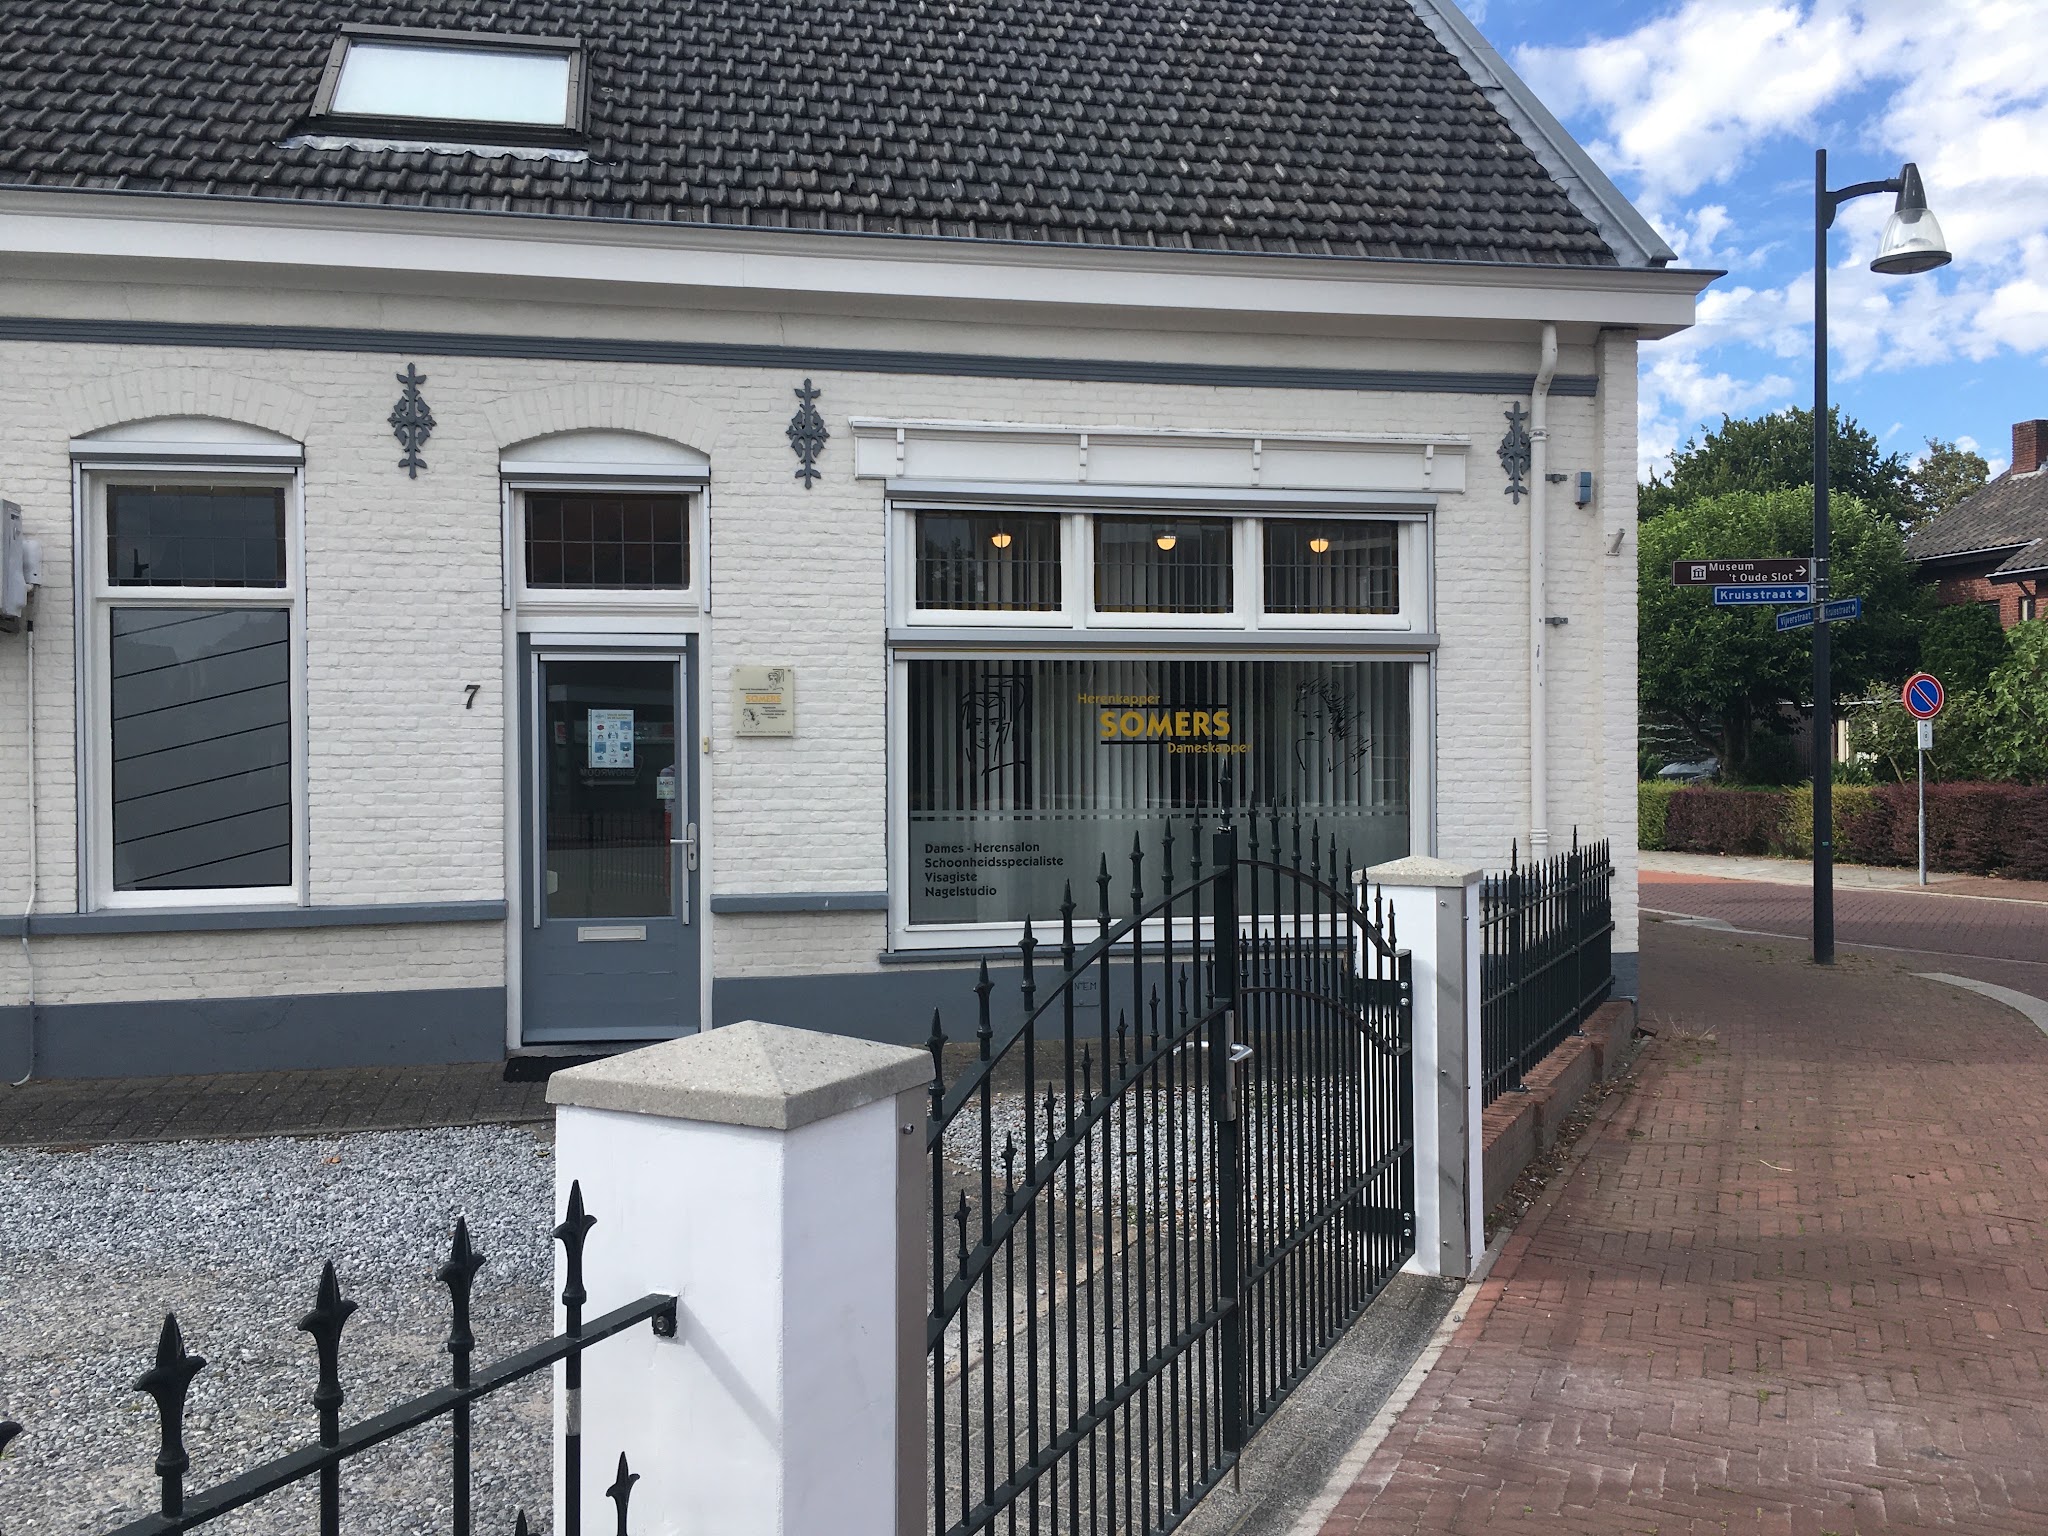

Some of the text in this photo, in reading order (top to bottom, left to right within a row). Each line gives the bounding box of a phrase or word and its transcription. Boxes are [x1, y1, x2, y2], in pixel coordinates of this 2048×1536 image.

[1708, 562, 1754, 572] Museum
[1729, 572, 1793, 582] 't Oude Slot
[1720, 589, 1793, 600] Kruisstraat
[1780, 611, 1812, 627] Vijverstraat
[464, 684, 481, 710] 7
[1077, 692, 1161, 707] Herenkapper
[1100, 710, 1231, 738] SOMERS
[1167, 741, 1252, 756] Dameskapper
[924, 843, 964, 854] Dames
[973, 841, 1041, 853] Herensalon
[924, 855, 1064, 869] Schoonheidsspecialiste
[924, 871, 978, 884] Visagiste
[924, 885, 997, 899] Nagelstudio
